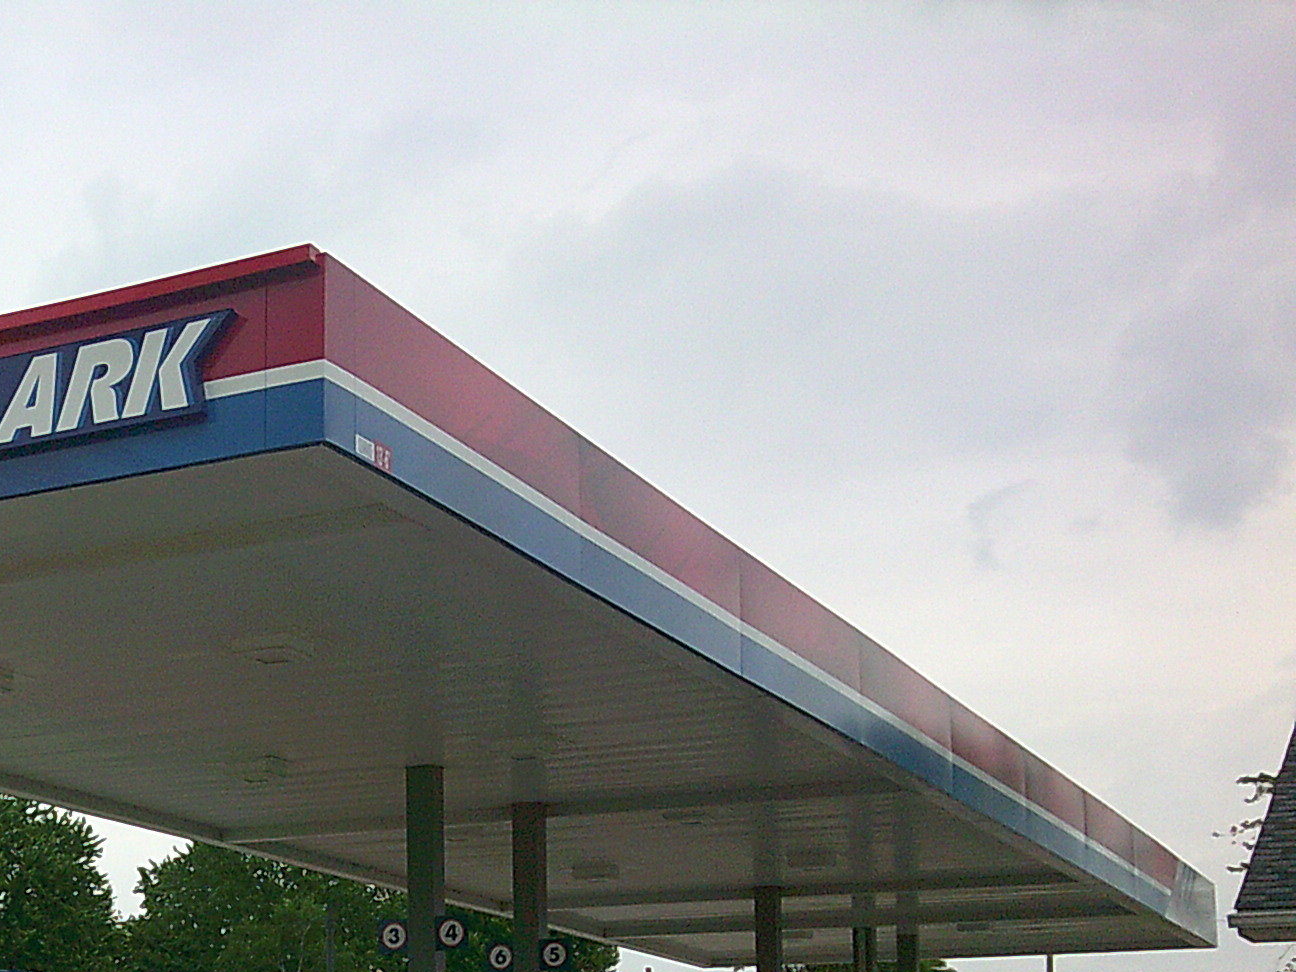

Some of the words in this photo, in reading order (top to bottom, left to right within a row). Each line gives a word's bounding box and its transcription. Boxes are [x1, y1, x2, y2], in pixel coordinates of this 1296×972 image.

[388, 928, 400, 944] 3
[445, 924, 458, 941] 4
[495, 949, 507, 964] 6
[550, 947, 560, 962] 5
